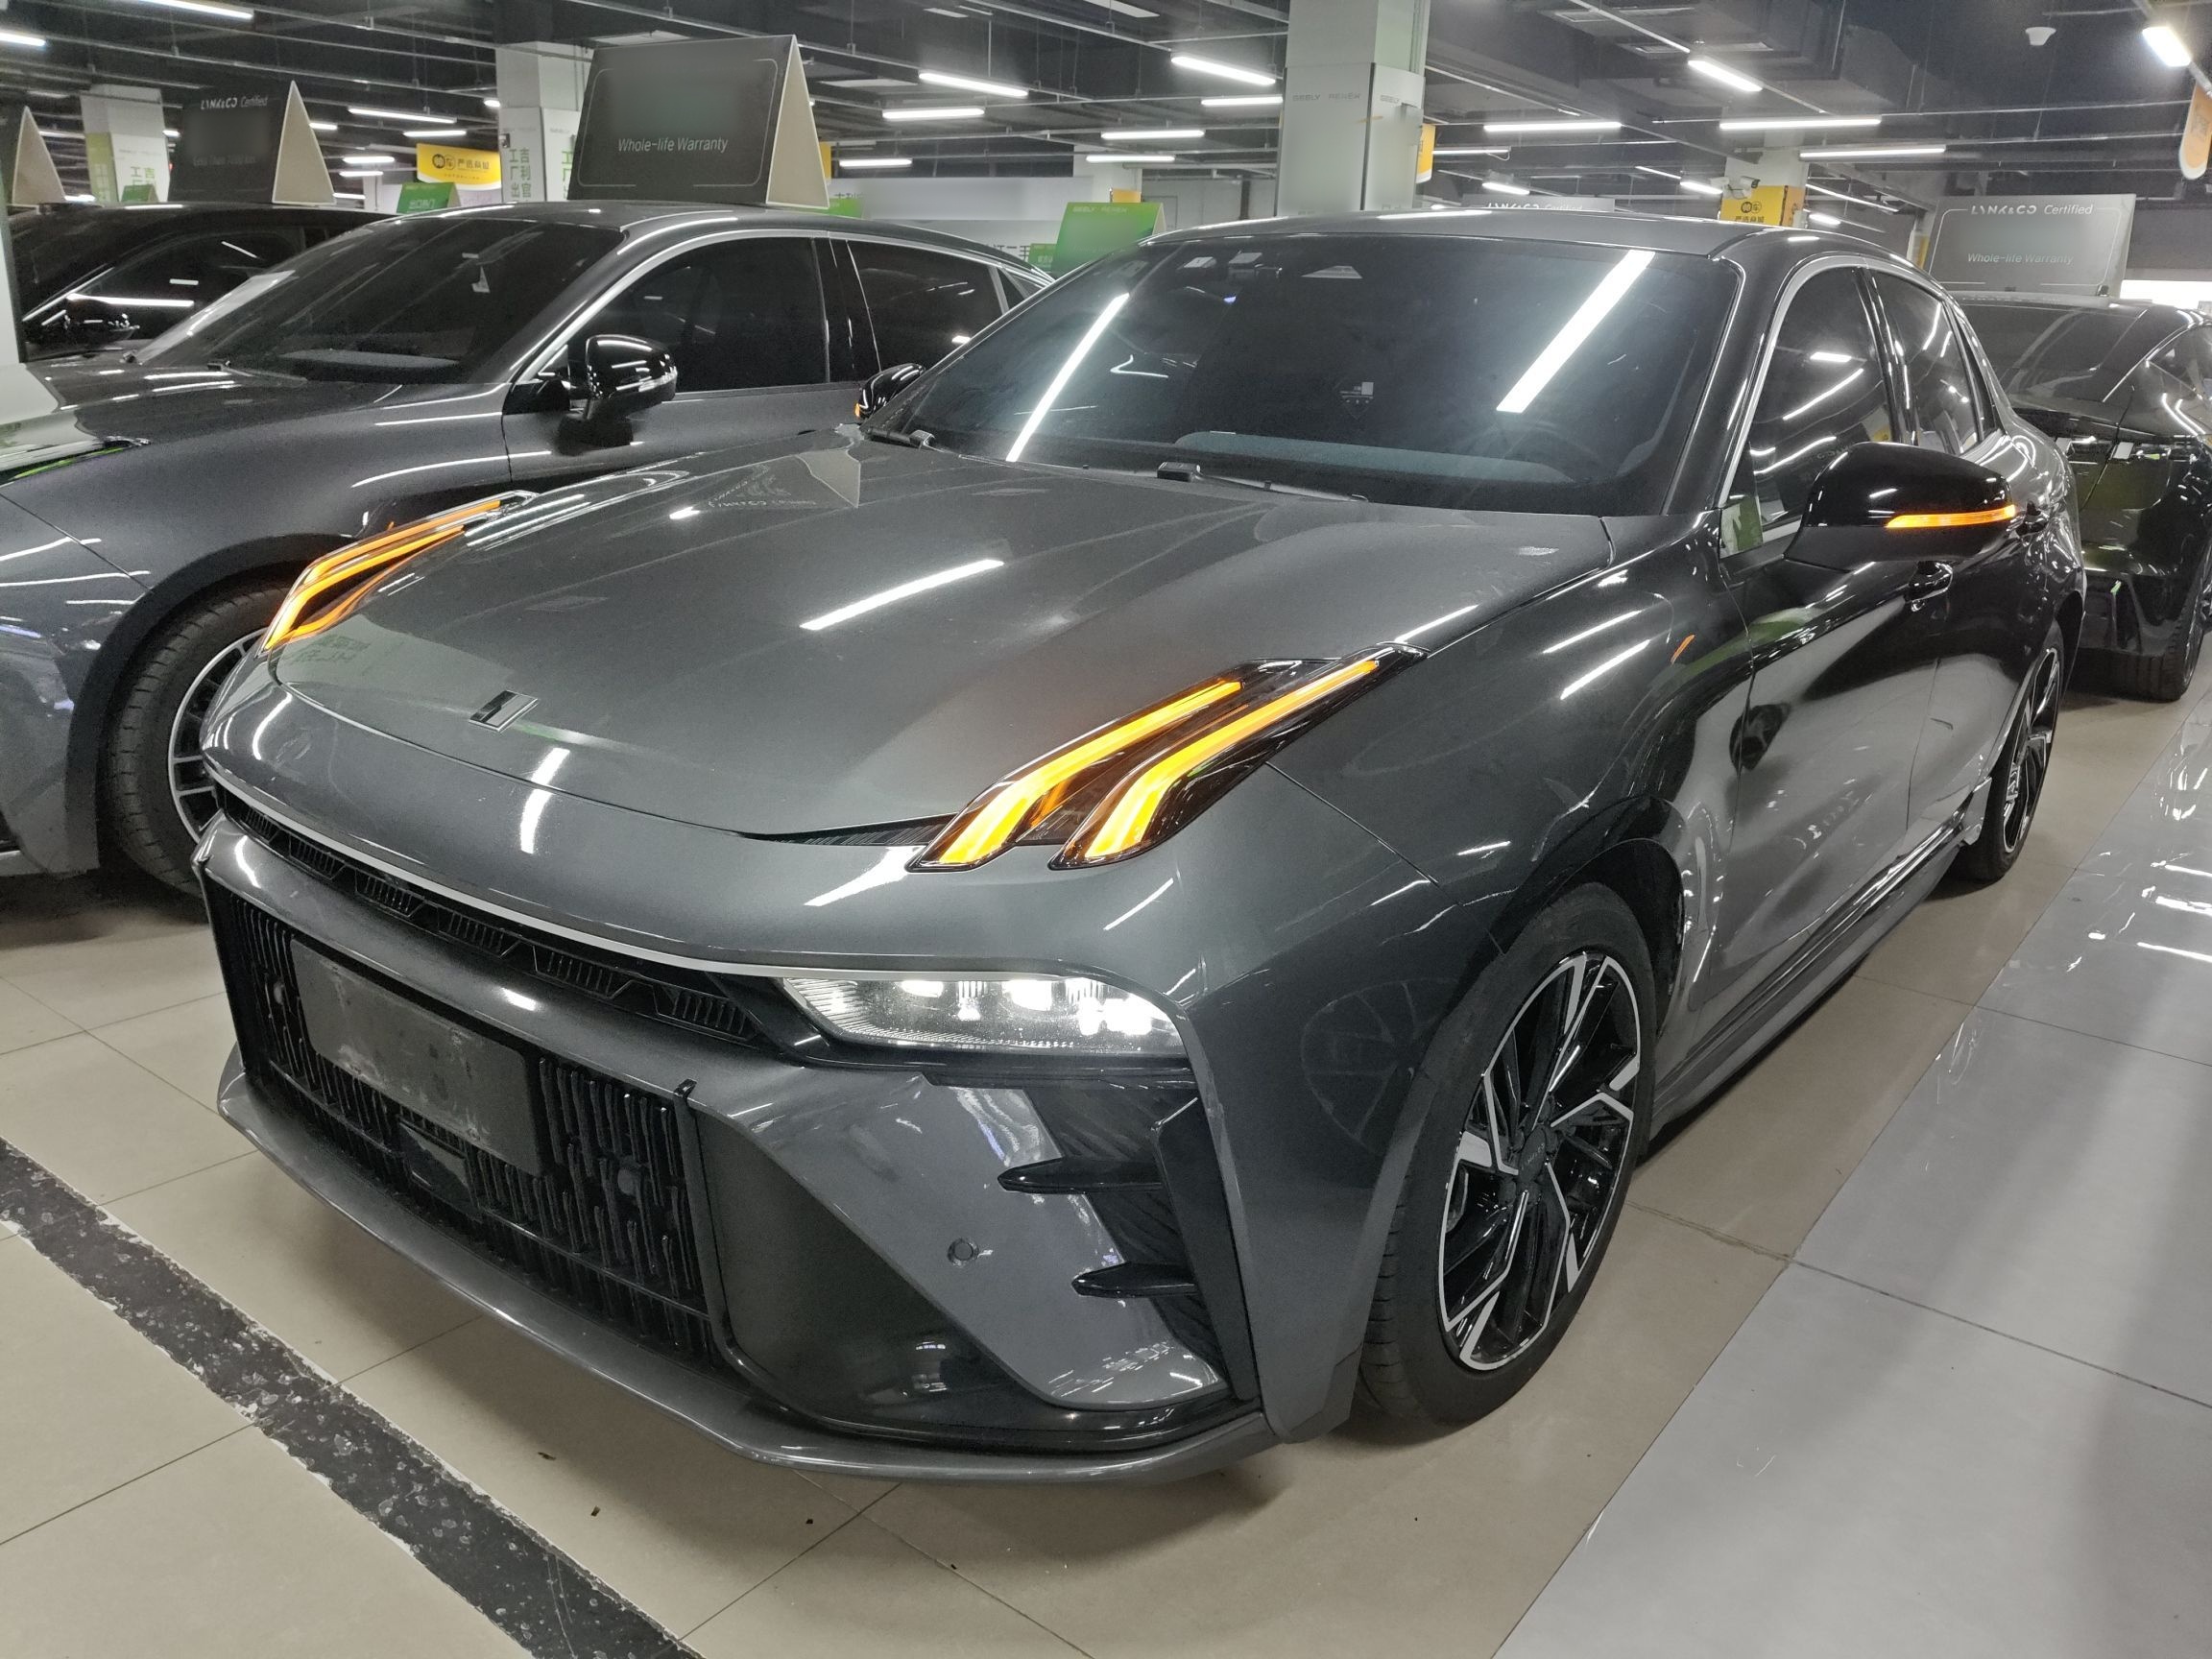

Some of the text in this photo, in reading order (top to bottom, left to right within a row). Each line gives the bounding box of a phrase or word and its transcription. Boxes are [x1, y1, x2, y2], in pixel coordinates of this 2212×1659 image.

[618, 136, 729, 154] Whole-life Warranty
[2044, 204, 2094, 215] Certified
[1968, 252, 2075, 266] Whole-life Warranty
